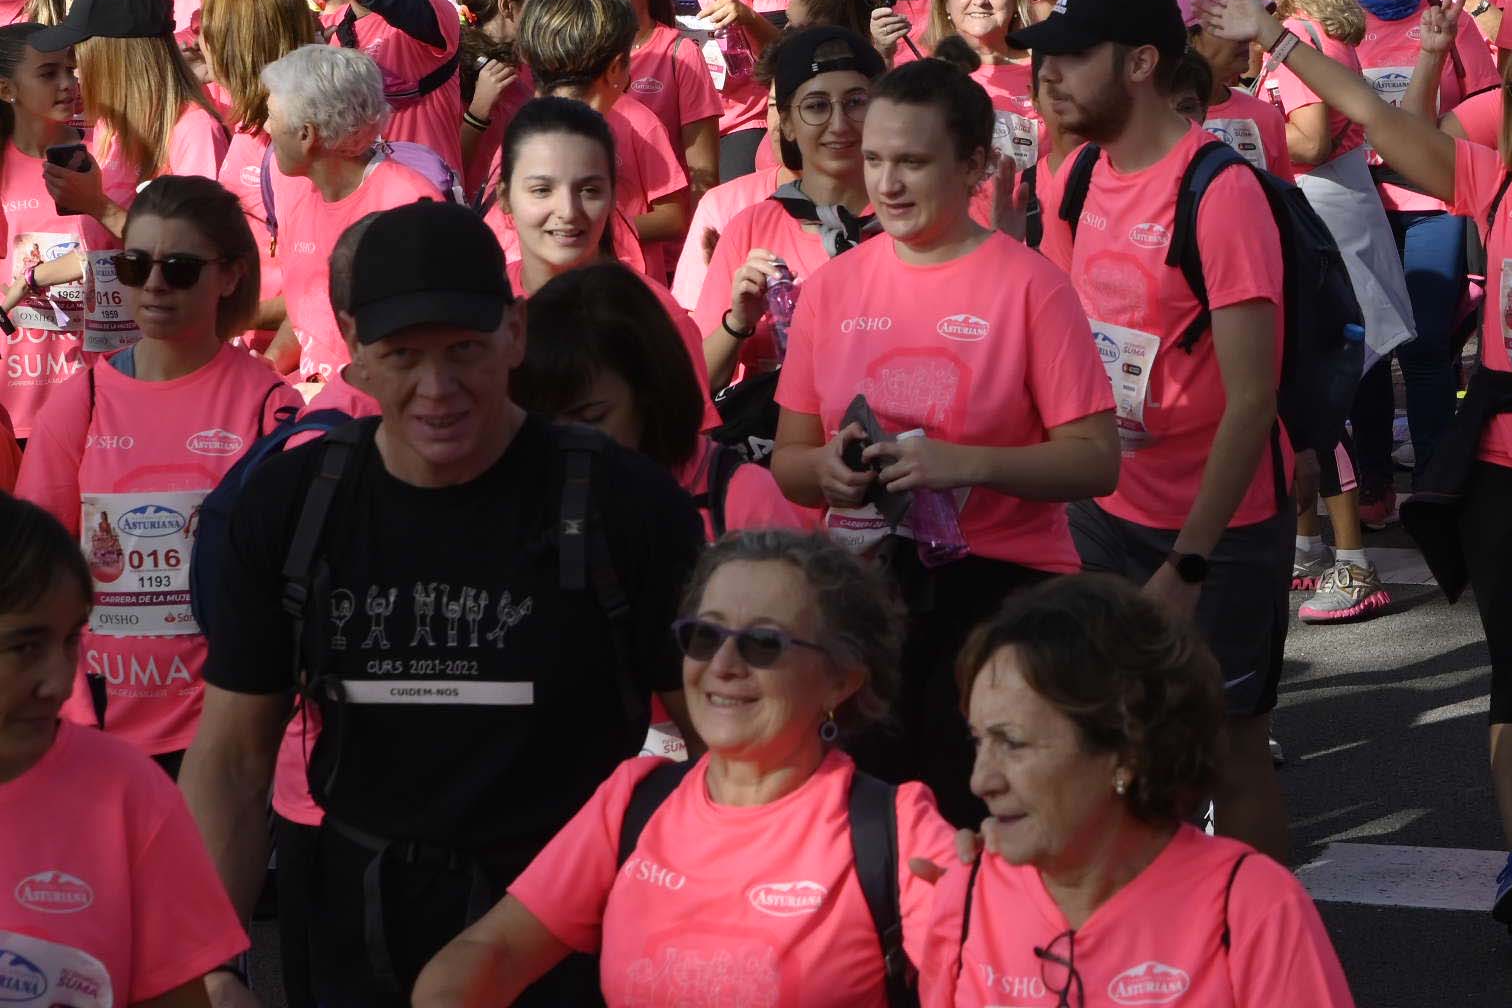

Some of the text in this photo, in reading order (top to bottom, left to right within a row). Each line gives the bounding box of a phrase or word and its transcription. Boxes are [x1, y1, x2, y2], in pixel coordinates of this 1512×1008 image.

[123, 516, 182, 531] ASTURIANA
[129, 548, 182, 570] 016
[138, 575, 172, 589] 1193
[100, 595, 138, 604] CARRERA
[138, 595, 151, 603] DE
[153, 594, 166, 603] LA
[99, 613, 140, 626] OYSHO
[86, 649, 193, 687] SUMA
[367, 659, 480, 676] CURS 2021-2022
[390, 687, 460, 698] CUIDEM-NOS
[22, 886, 88, 904] ASTURIANA
[1113, 979, 1184, 998] ASTURIANA
